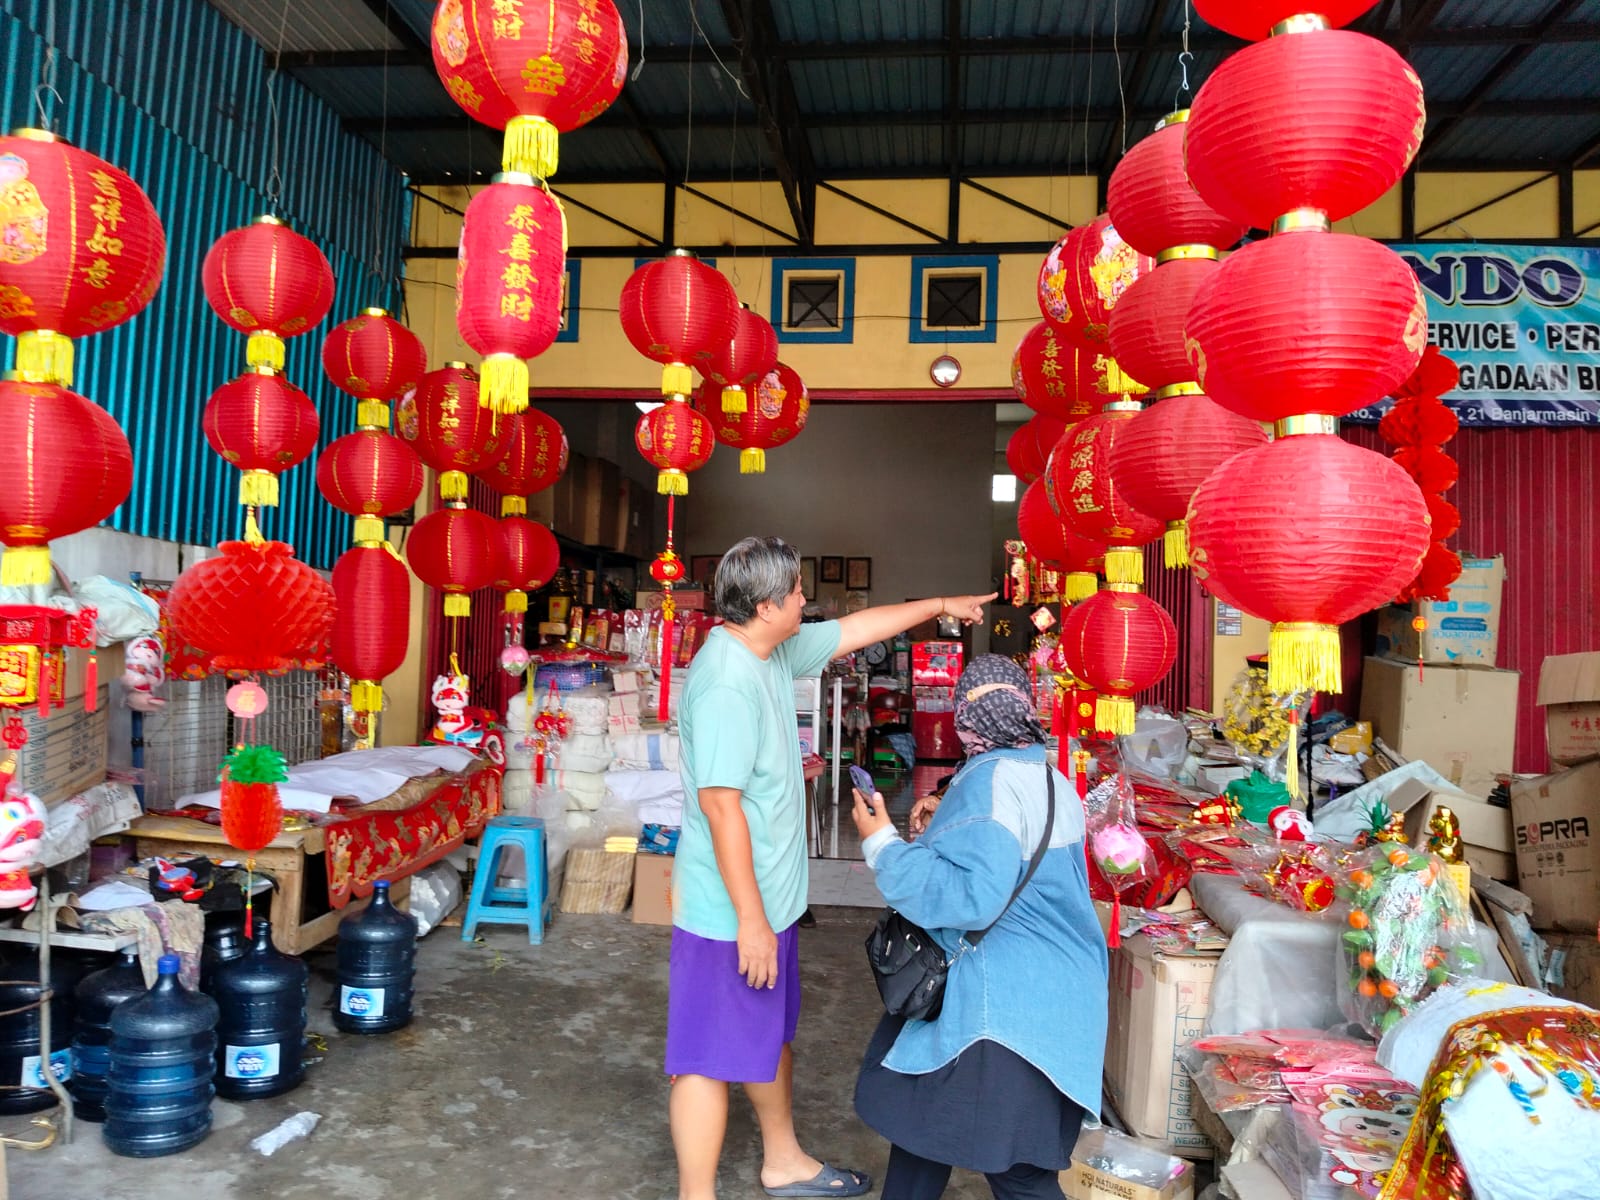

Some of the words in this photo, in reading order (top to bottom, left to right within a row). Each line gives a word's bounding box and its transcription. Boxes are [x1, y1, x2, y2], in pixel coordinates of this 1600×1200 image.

[498, 204, 543, 322] 恭喜發財
[1427, 322, 1517, 350] ERVICE
[1459, 364, 1569, 391] GADAAN
[1491, 406, 1591, 424] Banjarmasin
